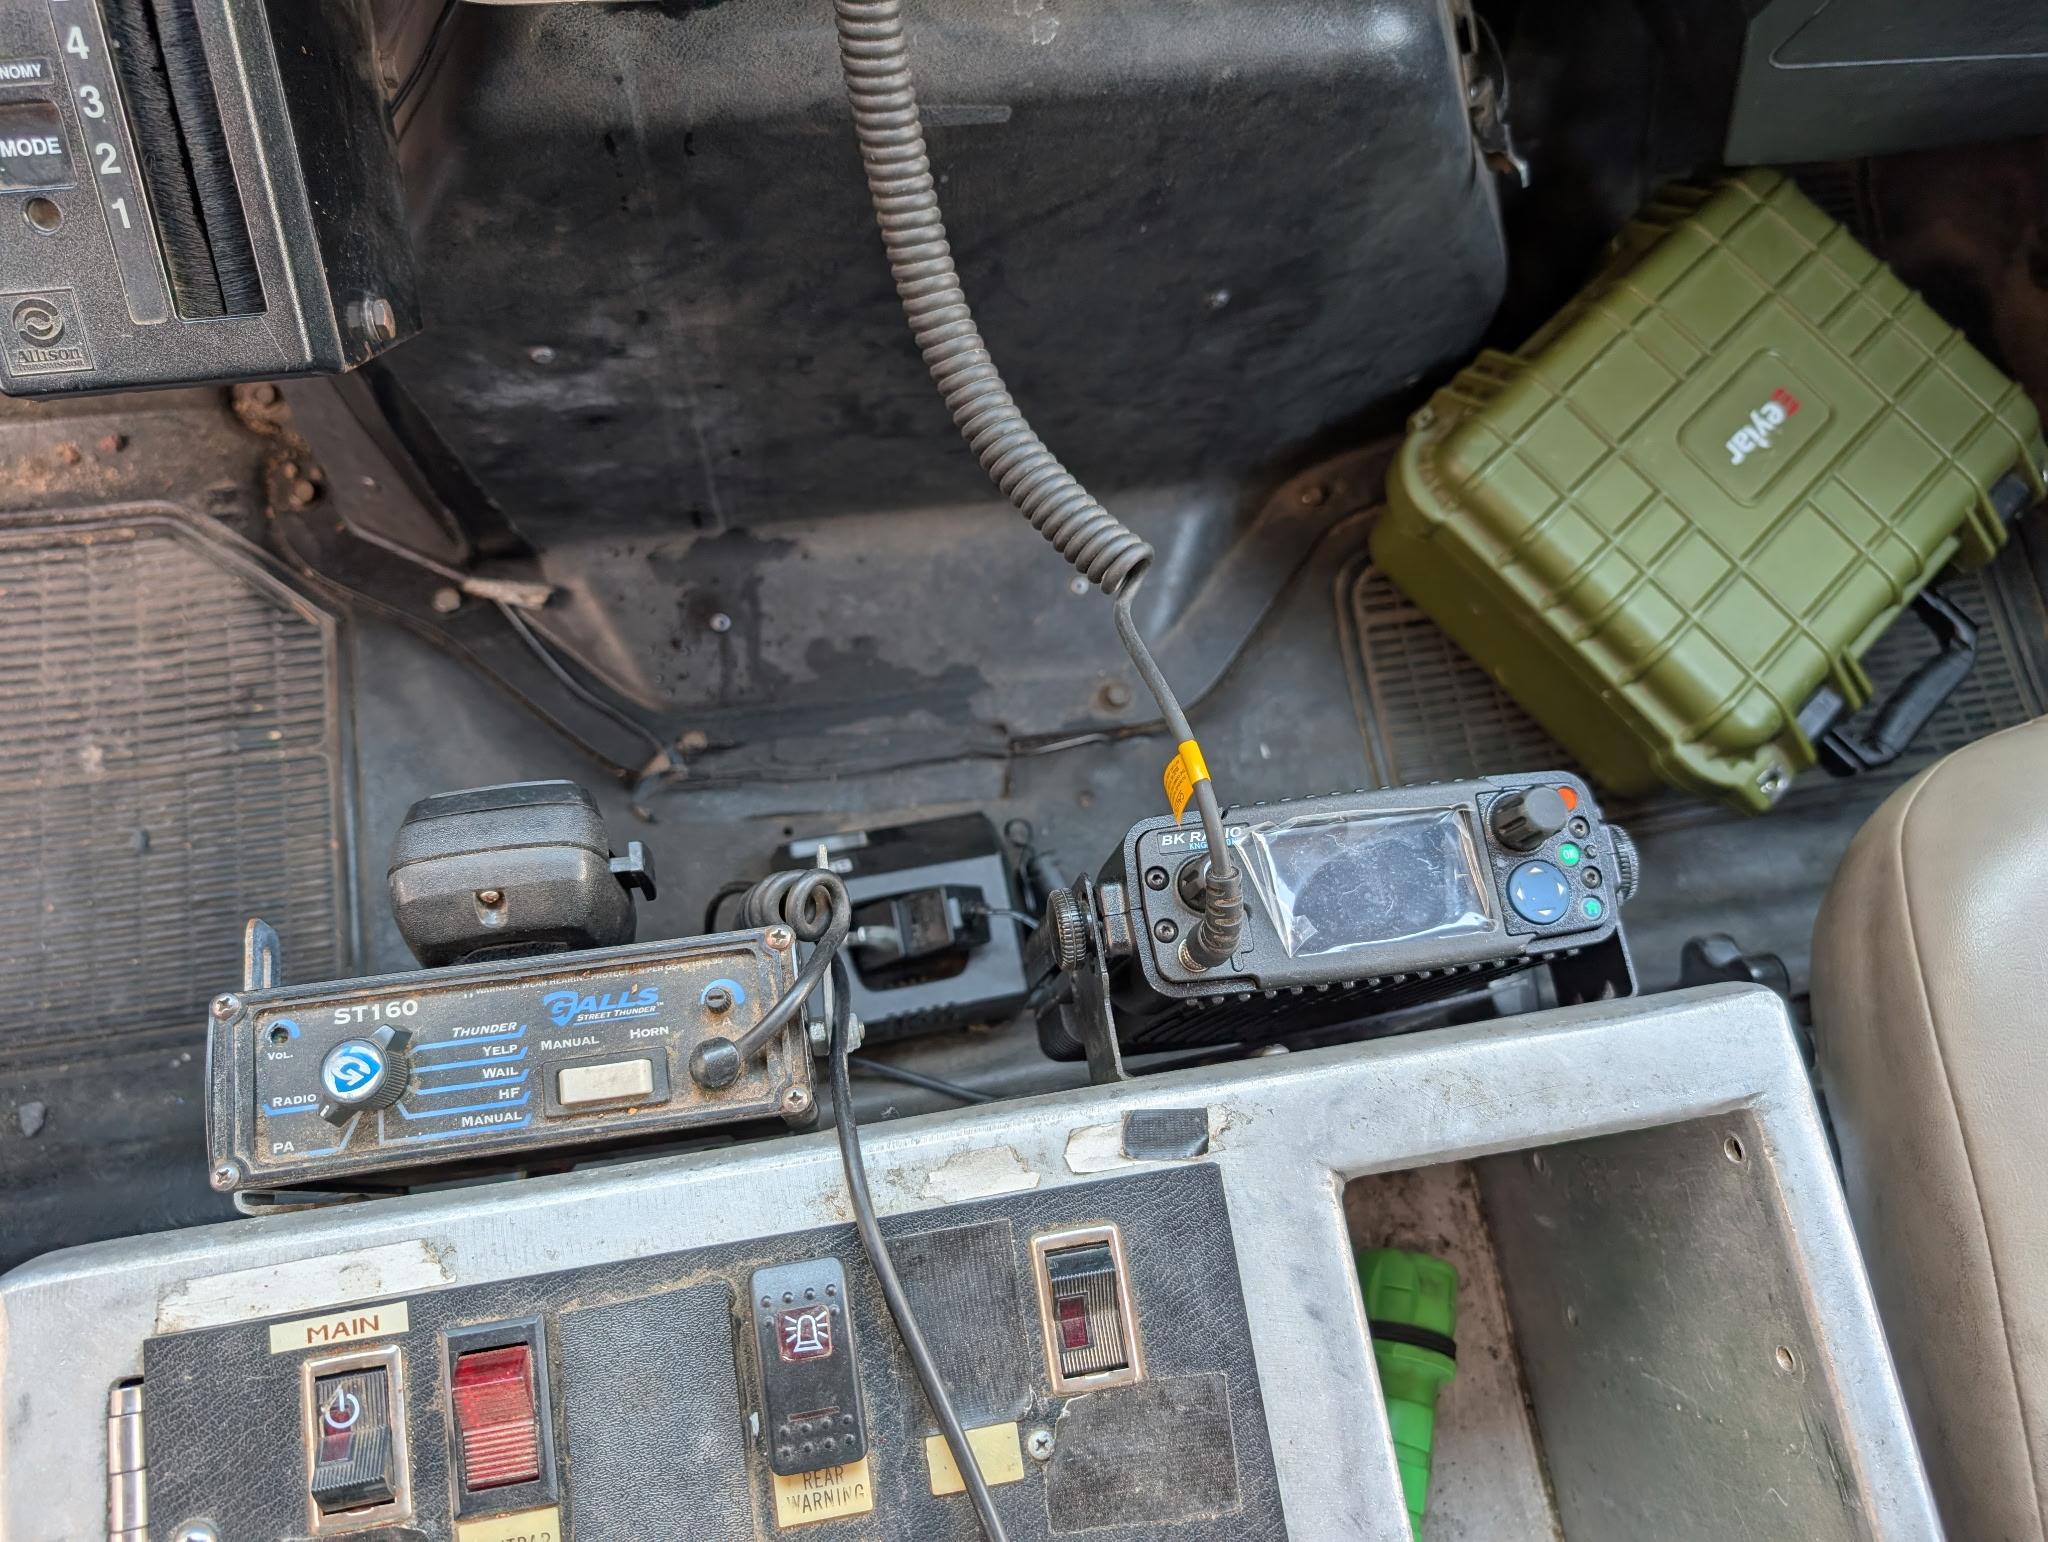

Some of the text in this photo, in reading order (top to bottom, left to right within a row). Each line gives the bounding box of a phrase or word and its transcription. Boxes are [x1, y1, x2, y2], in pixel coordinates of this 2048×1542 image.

[67, 26, 90, 60] 4
[79, 85, 105, 118] 3
[0, 137, 62, 158] MODE
[95, 143, 122, 175] 2
[111, 198, 131, 230] 1
[17, 347, 82, 363] Allison
[1725, 400, 1787, 465] eylar
[1161, 826, 1242, 846] BK RAIO
[665, 961, 690, 972] OSH
[334, 999, 418, 1026] ST160
[576, 1010, 611, 1022] STREET
[452, 1021, 518, 1038] THUNDER
[540, 1026, 670, 1051] MANUAL HORN
[267, 1051, 294, 1061] VOL.
[482, 1044, 518, 1057] YELP
[482, 1066, 519, 1079] WAIL
[272, 1093, 317, 1108] RADIO
[499, 1086, 521, 1100] HF
[461, 1111, 523, 1128] MANUAL
[273, 1141, 295, 1154] PA
[306, 1313, 380, 1345] MAIN
[802, 1465, 845, 1491] REAR
[786, 1483, 865, 1514] WARNING
